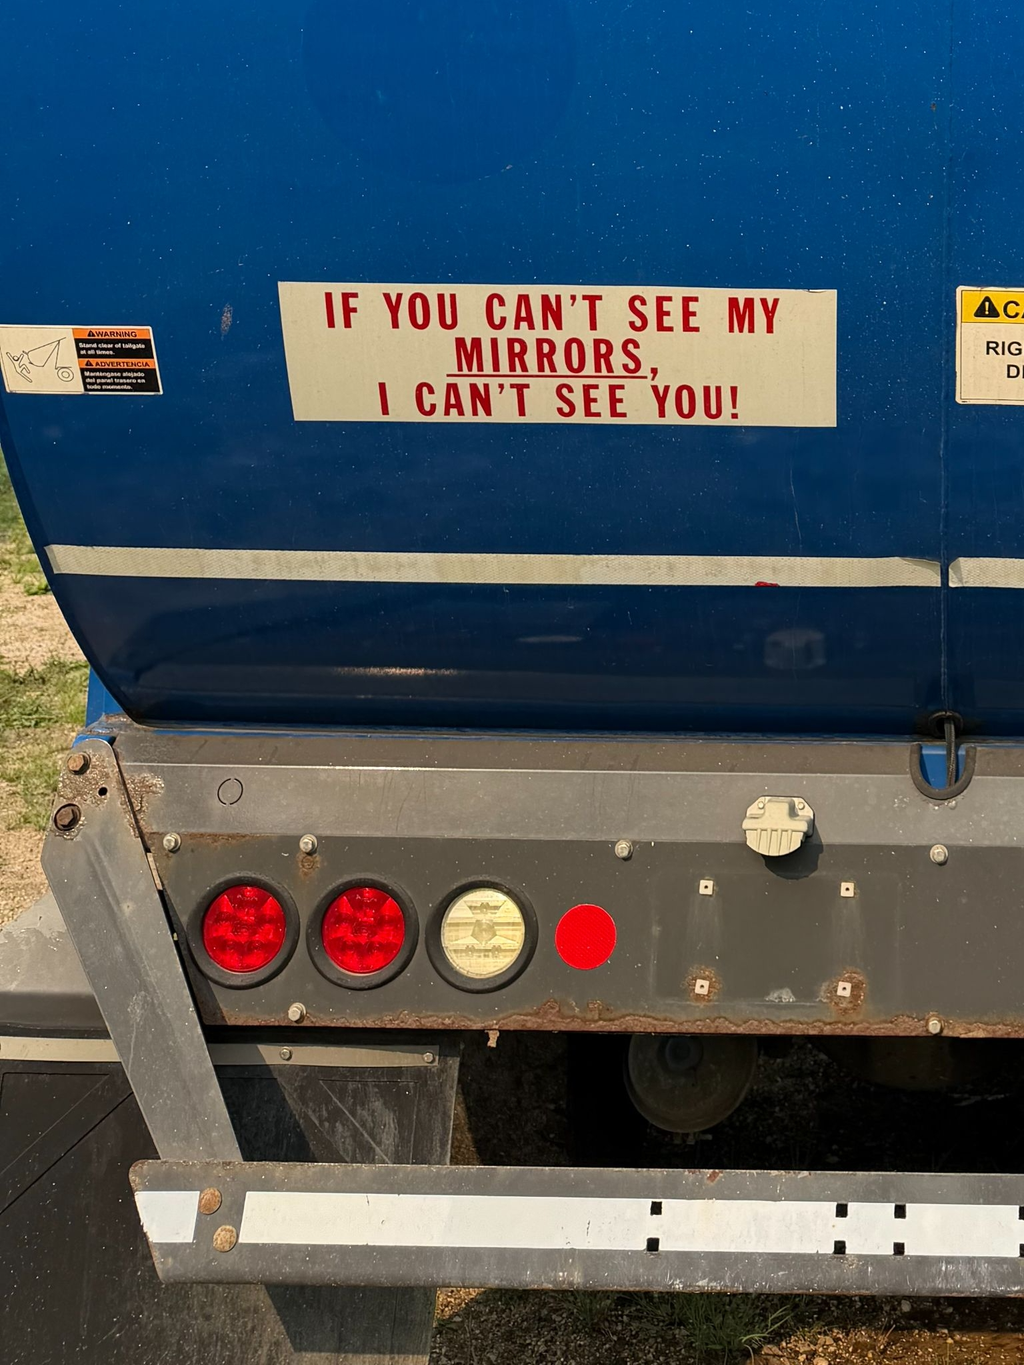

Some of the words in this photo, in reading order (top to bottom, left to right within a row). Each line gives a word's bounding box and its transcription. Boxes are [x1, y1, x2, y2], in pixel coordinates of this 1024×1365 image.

[325, 292, 359, 329] IF
[383, 293, 458, 330] YOU
[485, 293, 603, 332] CAN'T
[628, 295, 701, 333] SEE
[728, 297, 780, 334] MY
[454, 337, 658, 381] MIRRORS,
[378, 382, 390, 416] I
[415, 383, 531, 417] CAN'T
[556, 383, 628, 418] SEE
[651, 385, 739, 419] YOU!
